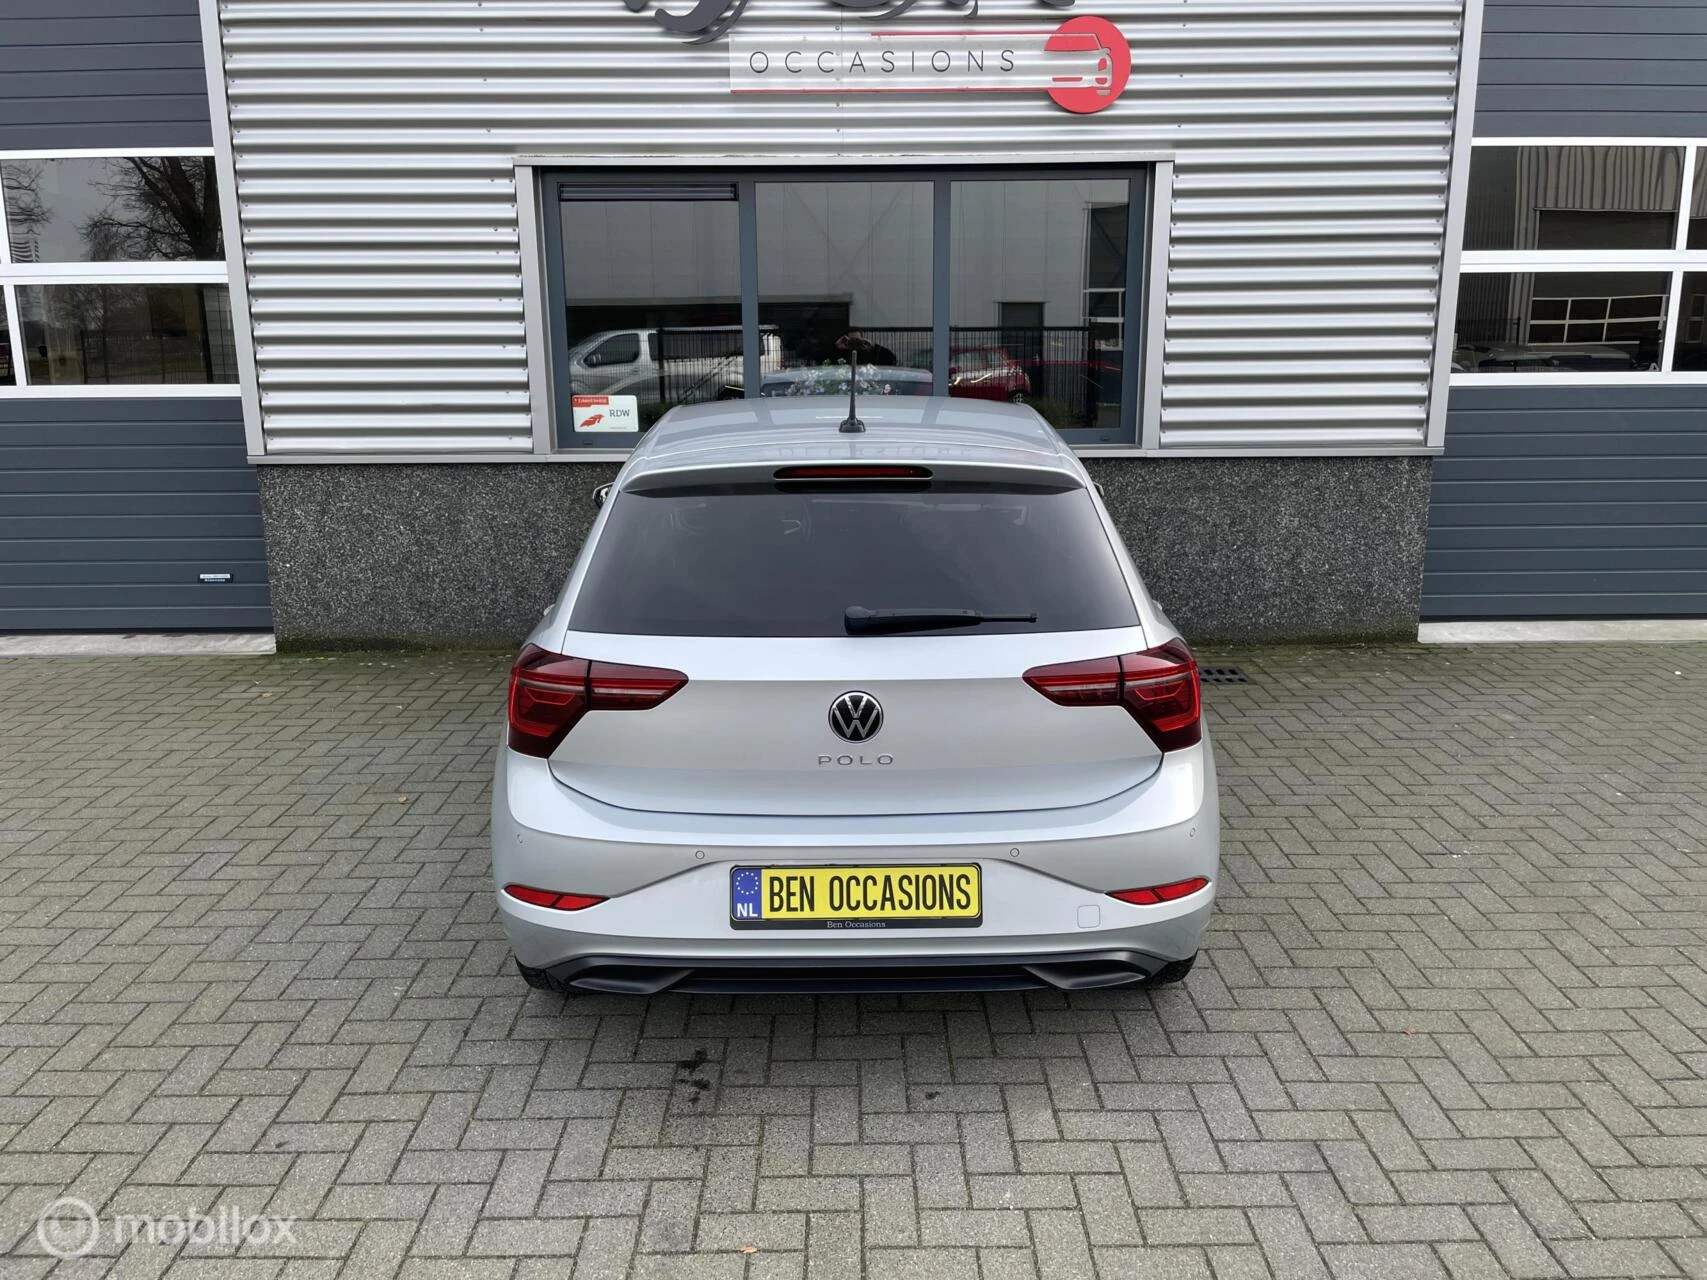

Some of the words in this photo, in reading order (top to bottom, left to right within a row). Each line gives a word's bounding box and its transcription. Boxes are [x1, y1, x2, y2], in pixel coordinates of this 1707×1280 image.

[749, 49, 1015, 73] OCCASIONS
[609, 409, 630, 417] RDW
[818, 755, 893, 765] POLO
[769, 875, 815, 912] BEN
[829, 873, 971, 911] OCCASIONS
[737, 903, 758, 917] NL
[827, 920, 843, 928] Ben
[844, 920, 886, 928] Occasions
